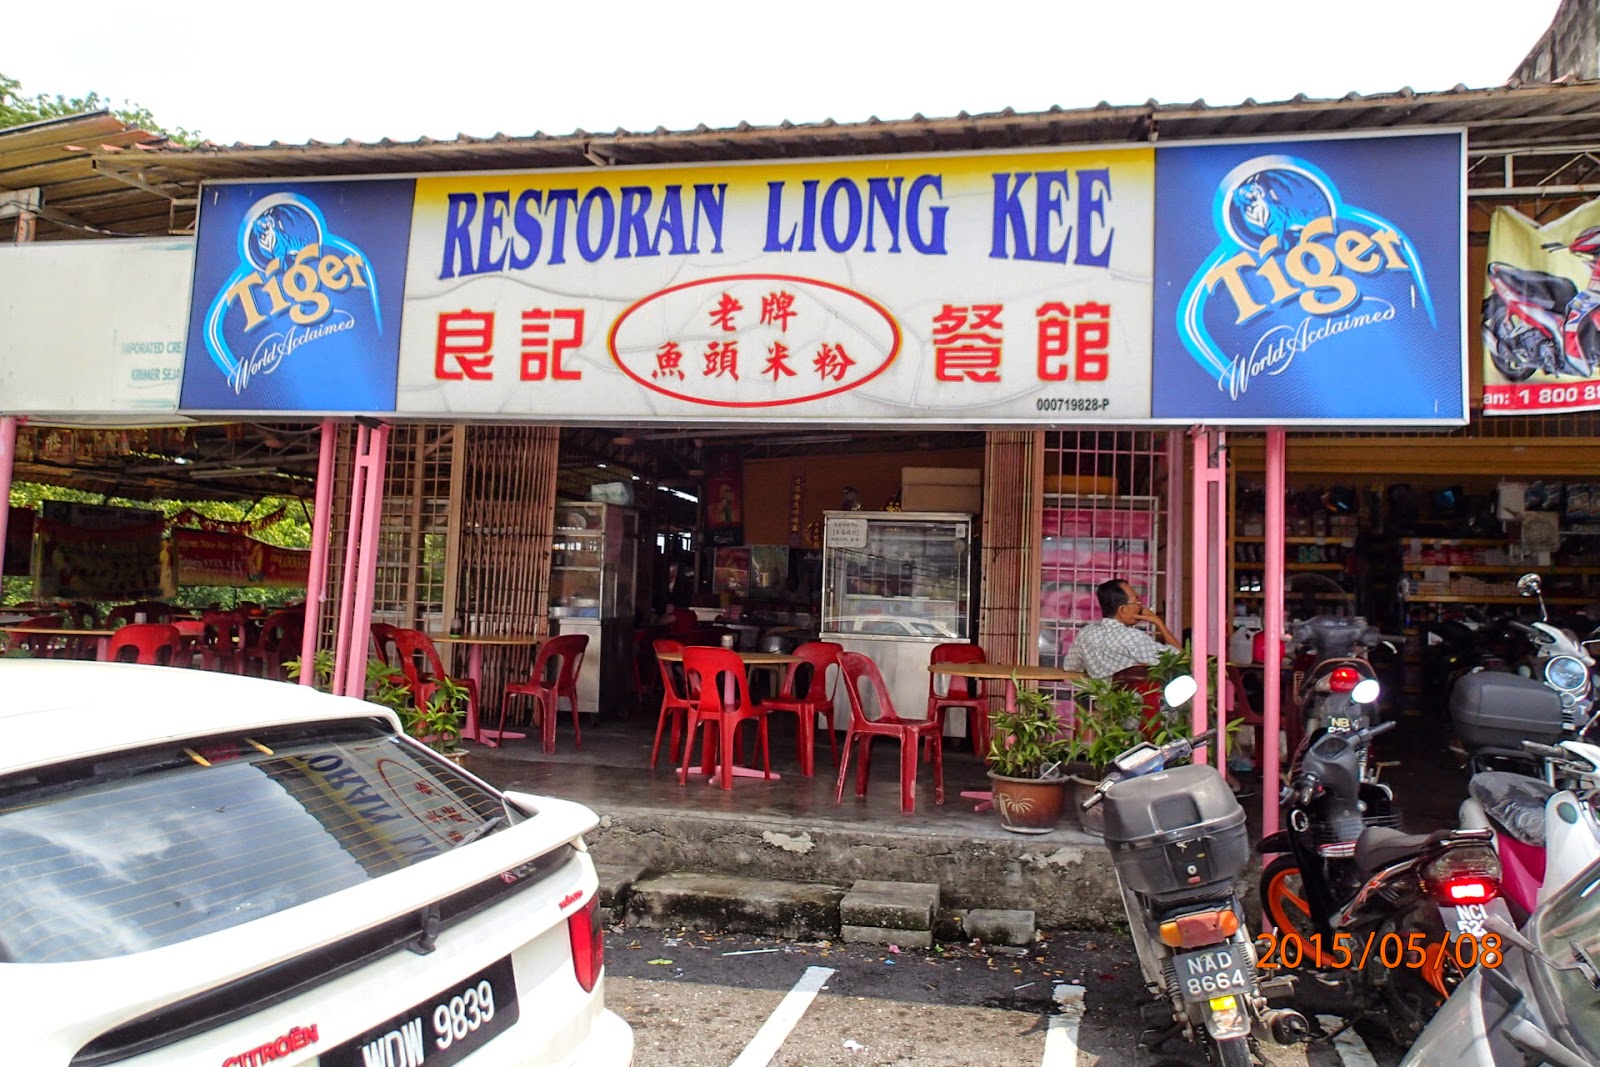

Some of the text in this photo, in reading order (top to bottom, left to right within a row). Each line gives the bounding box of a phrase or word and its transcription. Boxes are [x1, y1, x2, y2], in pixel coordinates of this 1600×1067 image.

[438, 168, 1115, 280] RESTORAN LIONG KEE
[226, 243, 368, 332] Tiger
[1206, 216, 1409, 325] Tiger
[434, 301, 1112, 383] 良記 餐館
[709, 291, 798, 333] 老牌
[167, 340, 183, 354] CRE
[228, 310, 355, 396] World Acclaimed
[651, 341, 857, 382] 魚頭米粉
[1219, 297, 1396, 401] World Acclaimed
[1036, 398, 1110, 412] 000719828-P
[1517, 389, 1530, 405] 1
[1538, 386, 1578, 404] 800
[1583, 384, 1600, 401] 8
[1187, 951, 1233, 975] NAD
[1187, 968, 1246, 996] 8664
[361, 979, 496, 1067] WDW 9839
